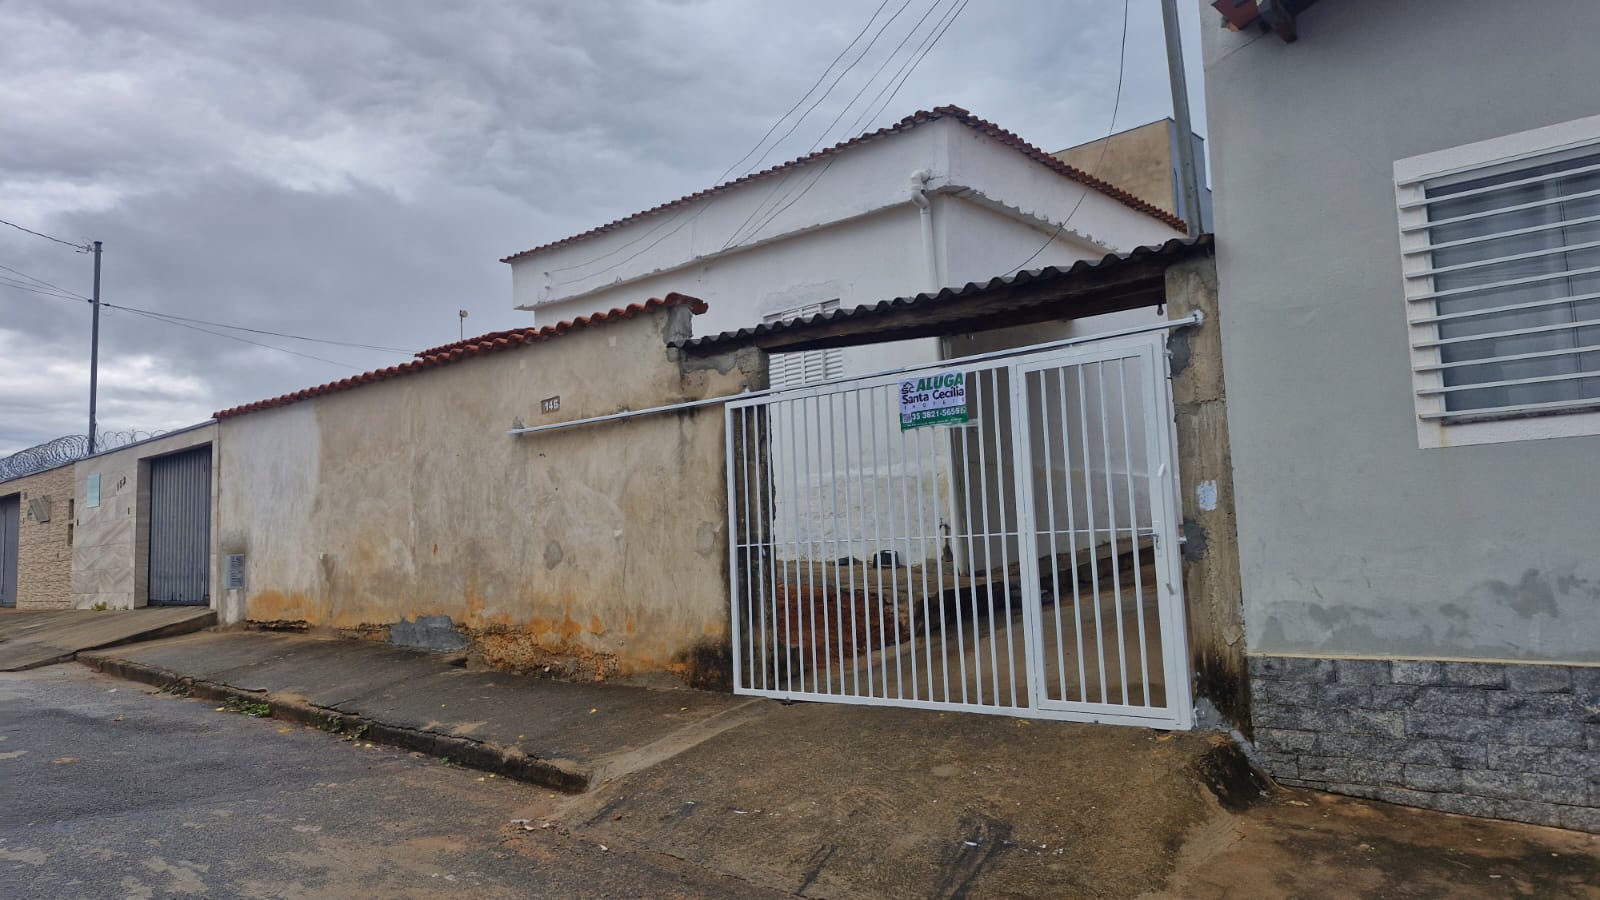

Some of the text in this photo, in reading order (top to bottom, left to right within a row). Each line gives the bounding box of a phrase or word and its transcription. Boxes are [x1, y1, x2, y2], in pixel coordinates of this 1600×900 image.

[916, 372, 964, 392] ALUGA
[902, 386, 965, 405] Santa Cecília
[911, 412, 921, 420] 35
